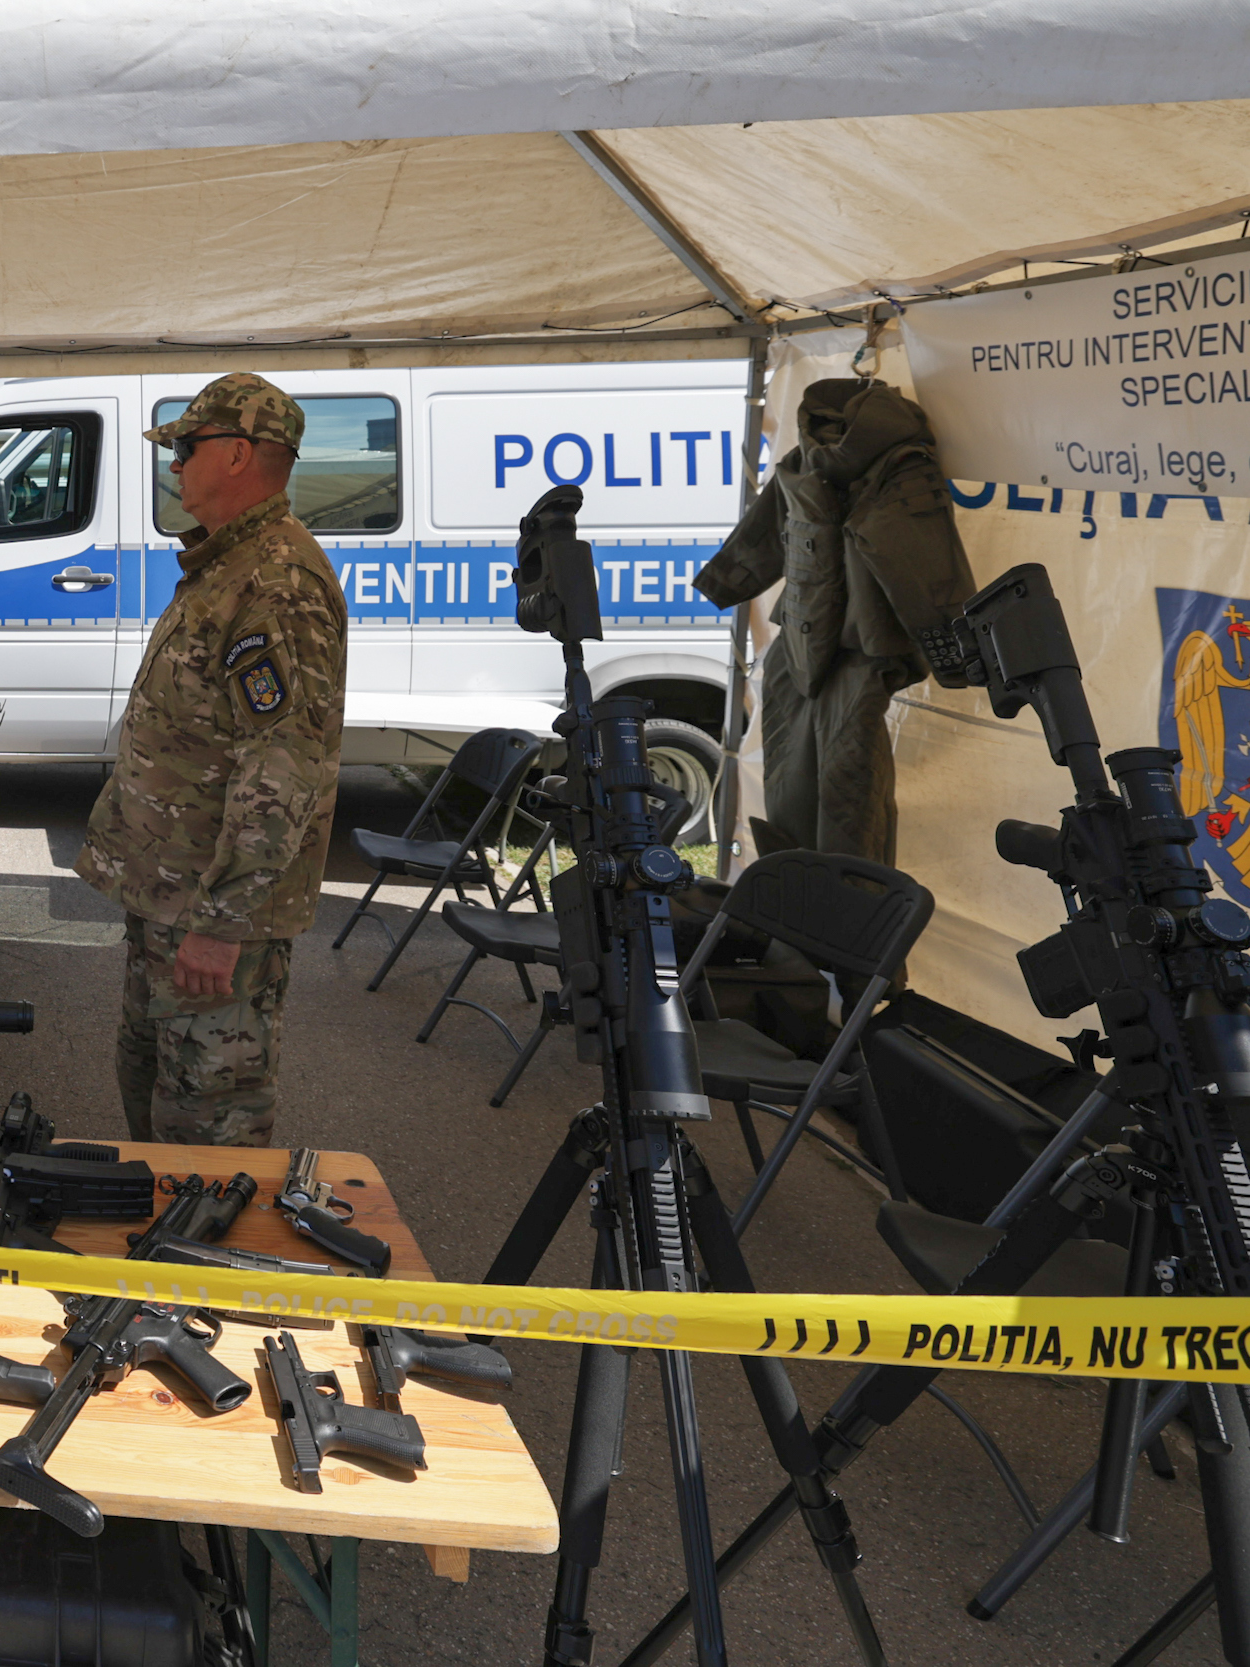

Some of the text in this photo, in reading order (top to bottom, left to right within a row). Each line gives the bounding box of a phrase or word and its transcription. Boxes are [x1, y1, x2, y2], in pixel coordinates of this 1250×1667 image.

[1113, 270, 1250, 320] SERVICI
[971, 320, 1250, 373] PENTRU INTERVEN
[1158, 442, 1236, 486] lege,
[1127, 1164, 1157, 1180] K700
[455, 1306, 540, 1334] NOT
[547, 1310, 679, 1344] CROSS
[1087, 1326, 1149, 1368] NU
